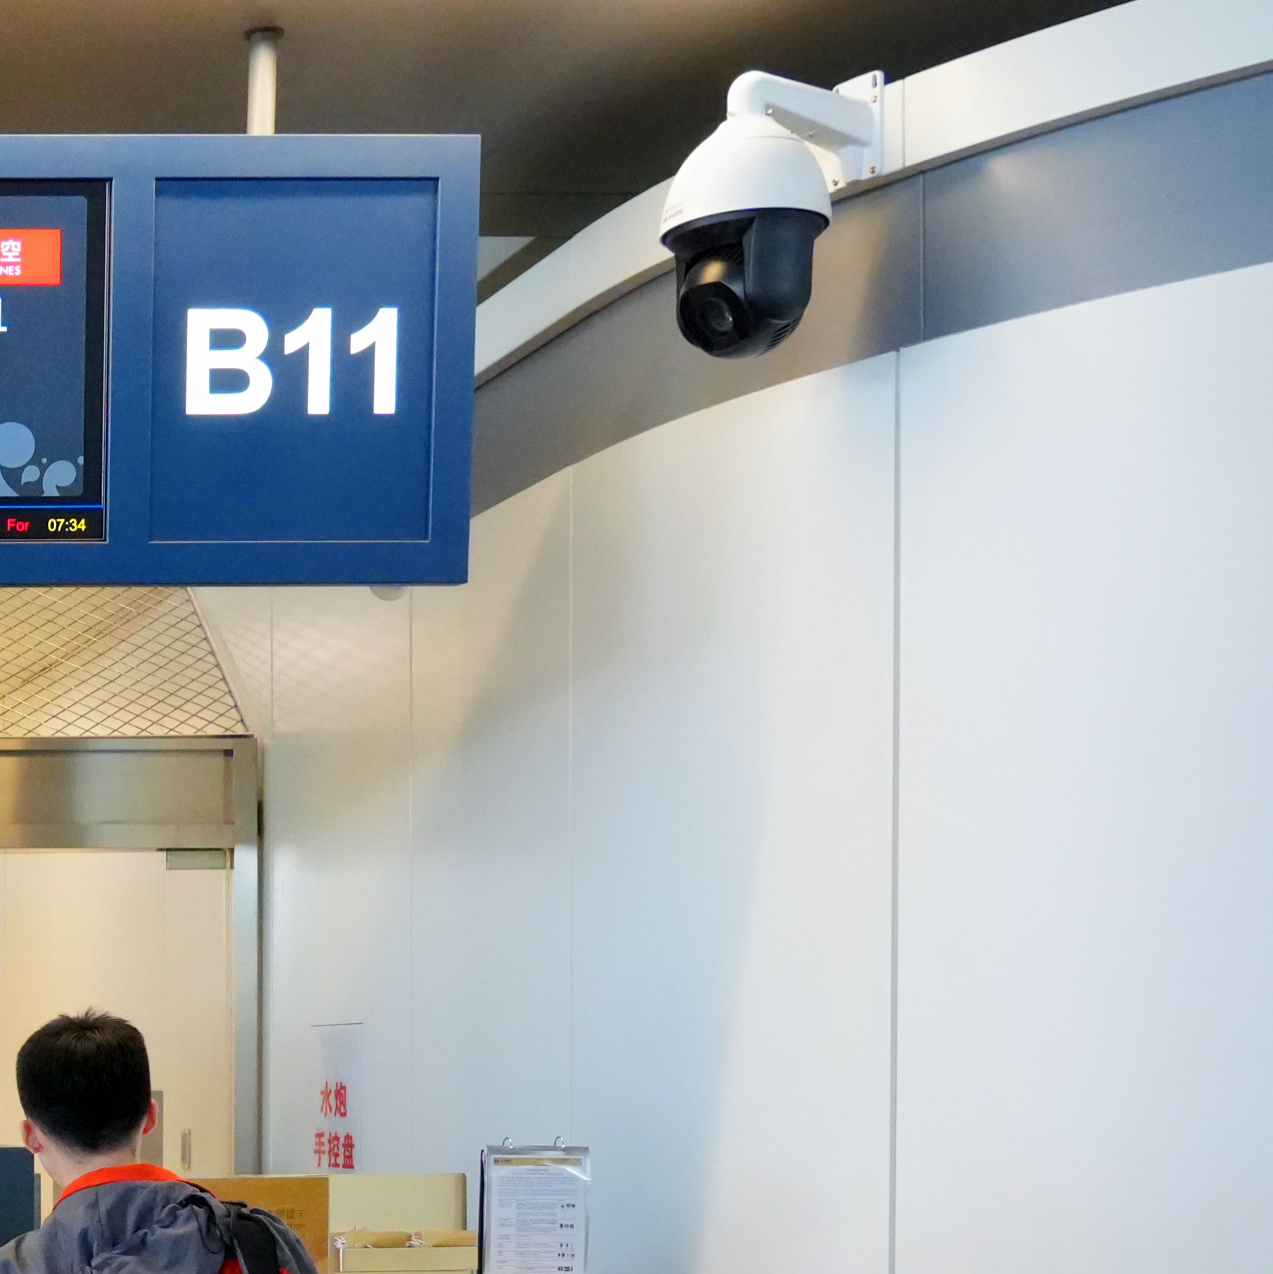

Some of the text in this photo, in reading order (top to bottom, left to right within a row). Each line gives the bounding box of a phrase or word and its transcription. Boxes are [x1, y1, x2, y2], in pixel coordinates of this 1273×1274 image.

[183, 306, 398, 416] B11
[6, 518, 30, 532] For
[47, 518, 86, 532] 07:34
[320, 1081, 347, 1117] 水炮
[314, 1132, 355, 1169] 手控盘
